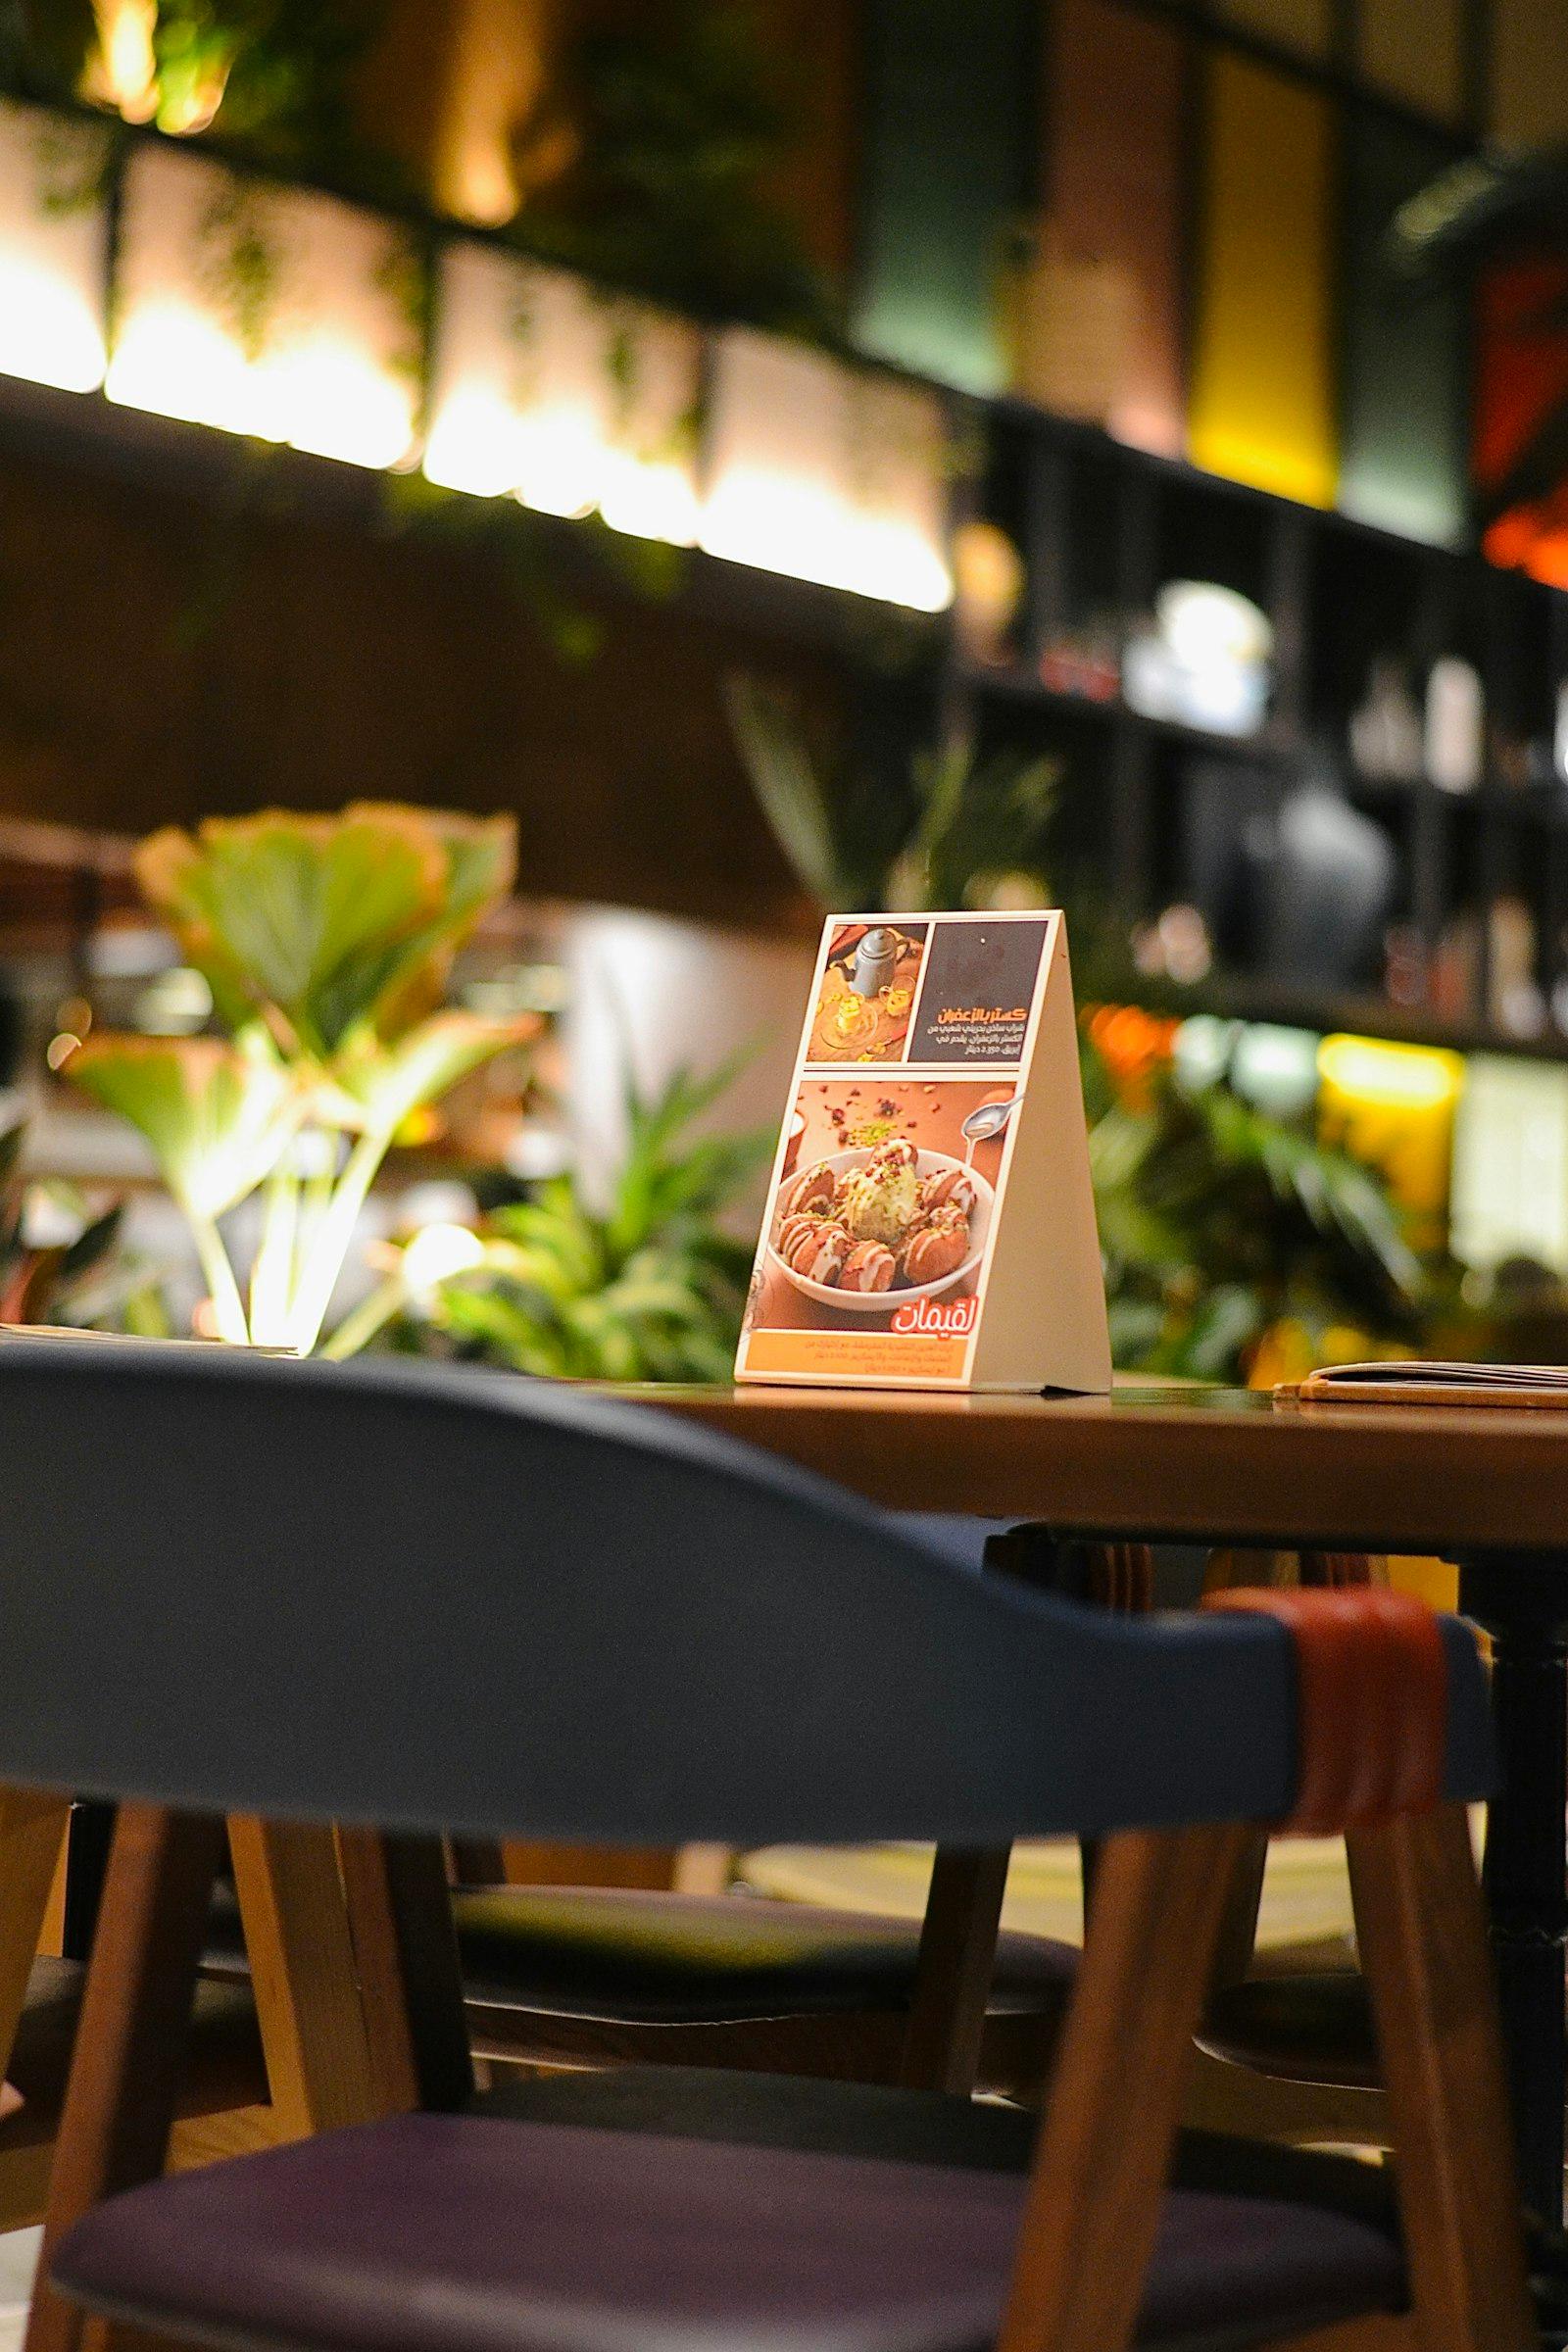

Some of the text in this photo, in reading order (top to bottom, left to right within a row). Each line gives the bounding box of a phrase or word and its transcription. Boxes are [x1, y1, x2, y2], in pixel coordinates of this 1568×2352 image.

[938, 1007, 1027, 1025] كستر بالزعفران
[894, 1296, 976, 1338] لقيمات
